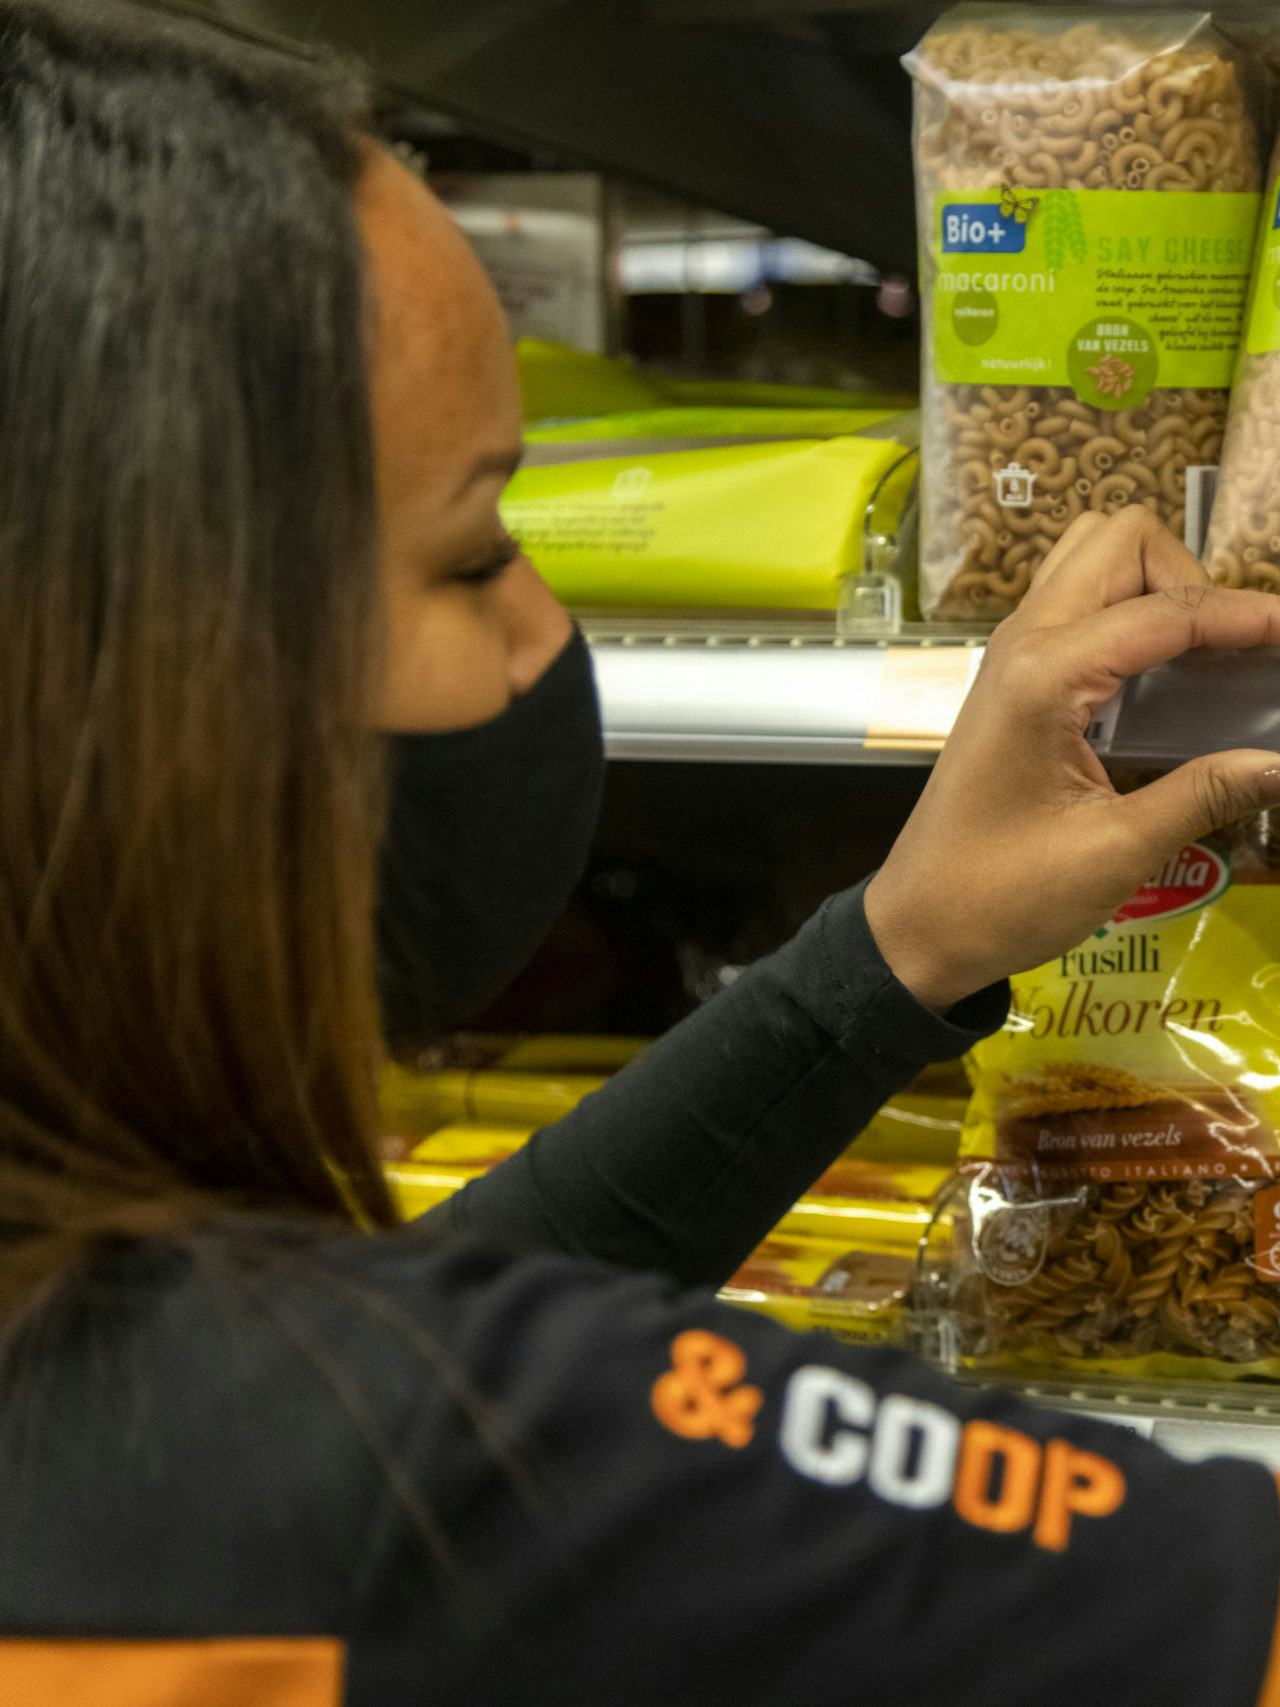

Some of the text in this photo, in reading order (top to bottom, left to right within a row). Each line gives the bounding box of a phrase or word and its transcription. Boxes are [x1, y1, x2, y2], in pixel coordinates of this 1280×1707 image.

[946, 214, 1006, 244] Bio+
[1097, 237, 1150, 264] SAY
[938, 268, 1055, 293] macaroni
[1038, 1123, 1183, 1152] Bron van vezels
[1125, 1162, 1225, 1177] ITALIANO
[651, 1328, 1127, 1553] & COOP
